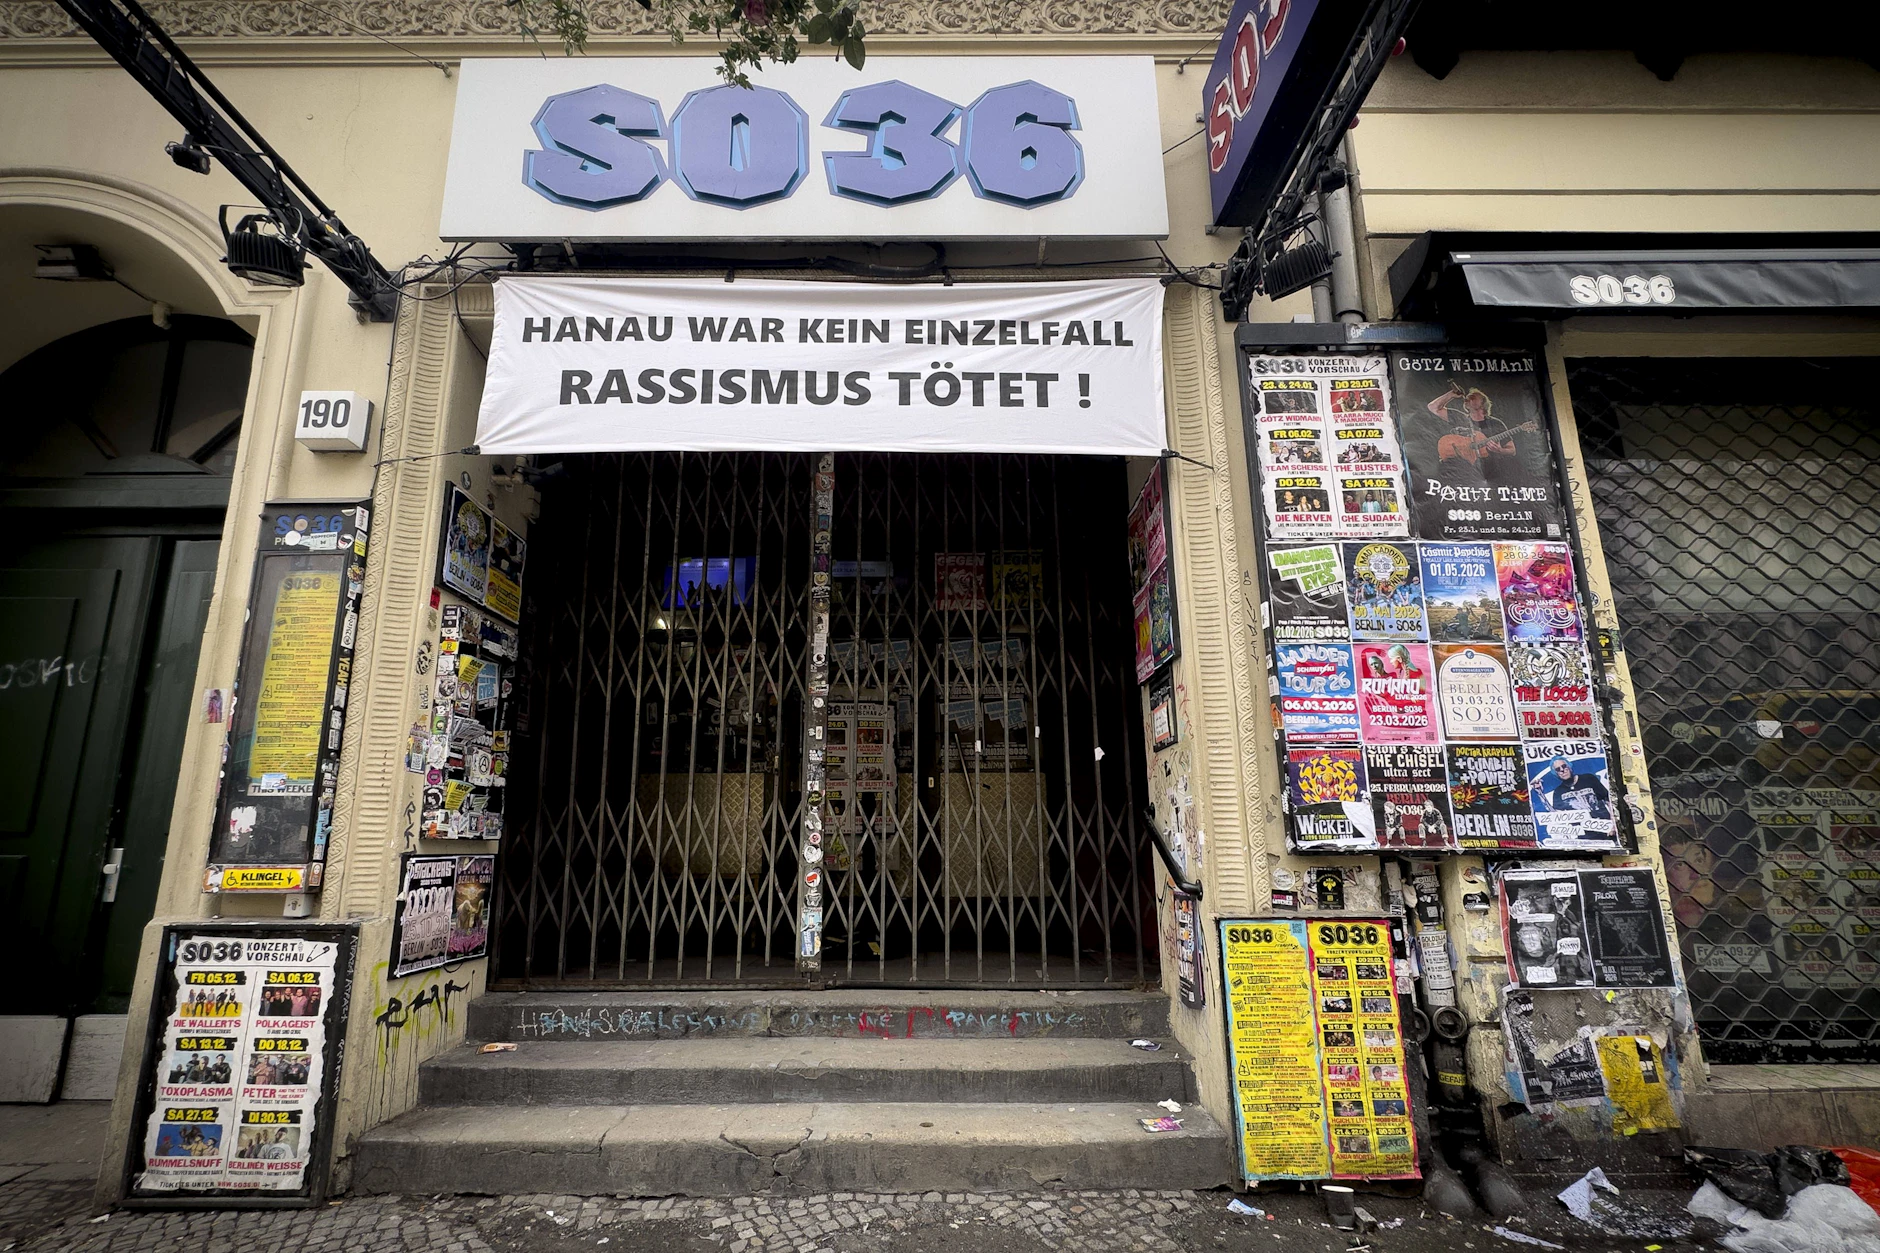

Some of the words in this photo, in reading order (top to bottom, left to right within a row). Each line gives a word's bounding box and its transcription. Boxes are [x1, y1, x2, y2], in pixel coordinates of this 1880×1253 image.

[522, 80, 1086, 211] SO36
[1570, 274, 1676, 305] SO36
[522, 317, 674, 344] HANAU
[689, 317, 785, 344] WAR
[799, 319, 891, 346] KEIN
[905, 319, 1133, 348] EINZELFALL
[1254, 358, 1308, 375] SO36
[559, 368, 871, 406] RASSISMUS
[888, 361, 1059, 408] TÖTET
[1078, 373, 1091, 408] !
[1278, 381, 1287, 389] &
[1335, 381, 1349, 389] DO
[301, 399, 350, 428] 190
[1273, 431, 1287, 439] FR
[1279, 479, 1293, 487] DO
[1345, 480, 1361, 488] SA
[1363, 479, 1389, 487] 14.02.
[1293, 514, 1332, 522] NERVEN
[1448, 510, 1481, 521] SO36
[937, 556, 985, 567] GEGEN
[1273, 548, 1334, 566] DANCING
[1360, 549, 1372, 565] MAD
[1374, 547, 1403, 564] CADDIES
[1430, 564, 1486, 577] 01.05.2026
[1301, 567, 1336, 591] EYES
[1373, 606, 1391, 618] MAI
[1355, 619, 1385, 631] BERLIN
[1397, 620, 1422, 631] SO36
[1276, 626, 1314, 638] 21.02.2026
[1315, 626, 1349, 638] SO36
[1278, 645, 1350, 667] WUNDER
[1281, 672, 1327, 693] TOUR
[1328, 672, 1350, 691] 26
[1362, 678, 1421, 696] ROMANO
[1450, 684, 1501, 694] BERLIN
[1516, 687, 1541, 702] THE
[1544, 686, 1589, 701] LOCOS
[1284, 701, 1355, 711] 06.03.2026
[1451, 696, 1504, 705] 19.03.26
[1404, 705, 1422, 713] SO36
[1452, 707, 1506, 722] SO36
[1285, 715, 1319, 724] BERLIN
[1329, 717, 1356, 725] SO36
[1370, 715, 1428, 726] 23.03.2026
[1522, 711, 1593, 725] 17.03.2026
[1528, 728, 1558, 737] BERLIN
[1566, 728, 1590, 737] SO36
[1554, 742, 1596, 756] SUBS
[1368, 754, 1393, 767] THE
[1397, 754, 1444, 767] CHISEL
[1383, 768, 1407, 777] ultra
[1412, 768, 1431, 777] sect
[1371, 784, 1383, 793] 25.
[1384, 784, 1424, 793] FEBRUAR
[1425, 784, 1446, 792] 2026
[1386, 793, 1427, 804] BERLIN
[1396, 805, 1424, 815] SO36
[1555, 813, 1574, 822] NOV
[1455, 814, 1511, 837] BERLIN
[1511, 824, 1534, 837] SO36
[1550, 826, 1580, 835] BERLIN
[241, 873, 284, 881] KLINGEL
[403, 915, 449, 941] 25.10.26
[1228, 928, 1273, 944] SO36
[1319, 924, 1379, 945] SO36
[182, 941, 244, 963] SO36
[247, 942, 297, 952] KONZERT
[403, 939, 425, 957] BERLIN
[247, 952, 304, 962] VORSCHAU
[190, 973, 205, 983] FR
[207, 973, 238, 983] 05.12.
[269, 973, 283, 983] SA
[287, 973, 316, 983] 06.12.
[173, 1019, 187, 1028] DIE
[189, 1019, 241, 1028] WALLERTS
[255, 1020, 316, 1028] POLKAGEIST
[180, 1039, 197, 1049] SA
[199, 1038, 227, 1049] 13.12.
[257, 1039, 274, 1050] DO
[276, 1039, 304, 1050] 18.12.
[160, 1087, 233, 1096] TOXOPLASMA
[242, 1088, 277, 1098] PETER
[167, 1110, 182, 1120] SA
[186, 1110, 215, 1121] 27.12.
[248, 1113, 259, 1123] DI
[261, 1113, 291, 1123] 30.12.
[148, 1159, 223, 1168] RUMMELSNUFF
[229, 1161, 265, 1170] BERLINER
[267, 1161, 303, 1170] WEISSE
